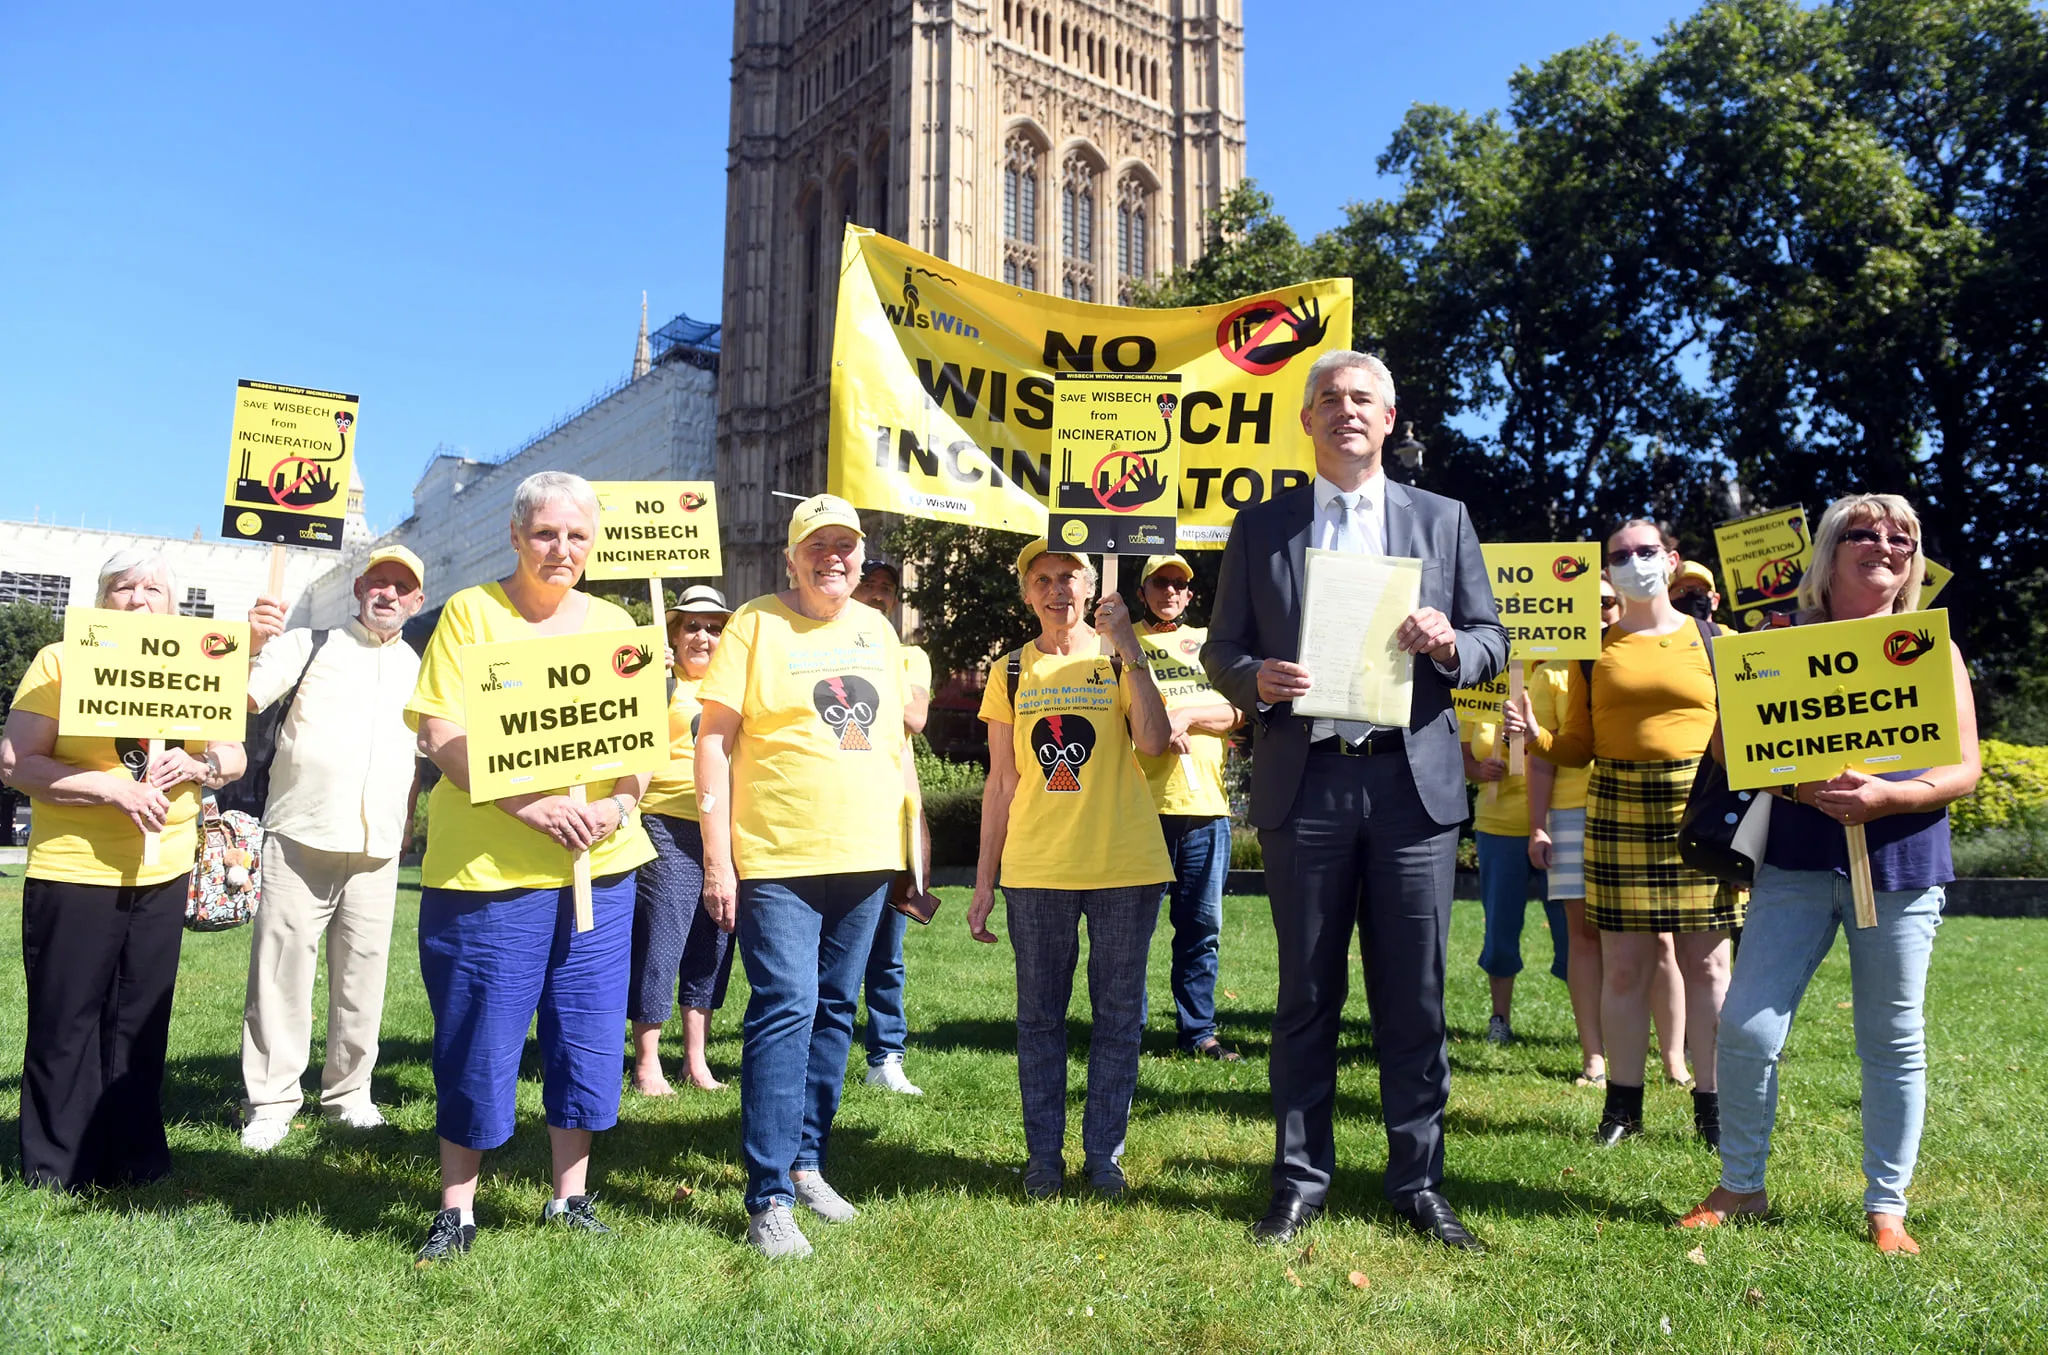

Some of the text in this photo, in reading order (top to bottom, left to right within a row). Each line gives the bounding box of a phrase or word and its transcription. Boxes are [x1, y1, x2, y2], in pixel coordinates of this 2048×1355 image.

[1043, 330, 1156, 372] NO
[917, 358, 1274, 444] WISCH
[1060, 391, 1151, 403] SAVE WISBECH
[243, 400, 330, 417] SAVE WISBECH
[1090, 410, 1118, 420] from
[271, 418, 297, 429] from
[238, 430, 332, 452] INCINERATION
[1058, 429, 1156, 441] INCINERATION
[635, 500, 665, 514] NO
[925, 497, 967, 511] WisWIN
[604, 525, 698, 540] WISBECH
[1742, 520, 1785, 536] WISBECH
[1744, 537, 1764, 547] from
[597, 548, 710, 562] INCINERATOR
[1726, 542, 1795, 564] INCINERATION
[1497, 567, 1533, 583] NO
[1494, 597, 1573, 614] SBECH
[1507, 627, 1587, 640] ERATOR
[140, 637, 180, 657] NO
[1145, 648, 1168, 661] NO
[1155, 664, 1202, 681] BECH
[1808, 651, 1859, 678] NO
[94, 667, 220, 692] WISBECH
[547, 663, 591, 689] NO
[1020, 686, 1108, 698] Kill the Monster
[78, 698, 232, 720] INCINERATOR
[1054, 697, 1061, 705] it
[1065, 696, 1088, 704] kills
[1092, 697, 1113, 706] you
[1757, 685, 1919, 725] WISBECH
[500, 697, 638, 736] WISBECH
[1746, 723, 1941, 762] INCINERATOR
[488, 731, 655, 773] INCINERATOR
